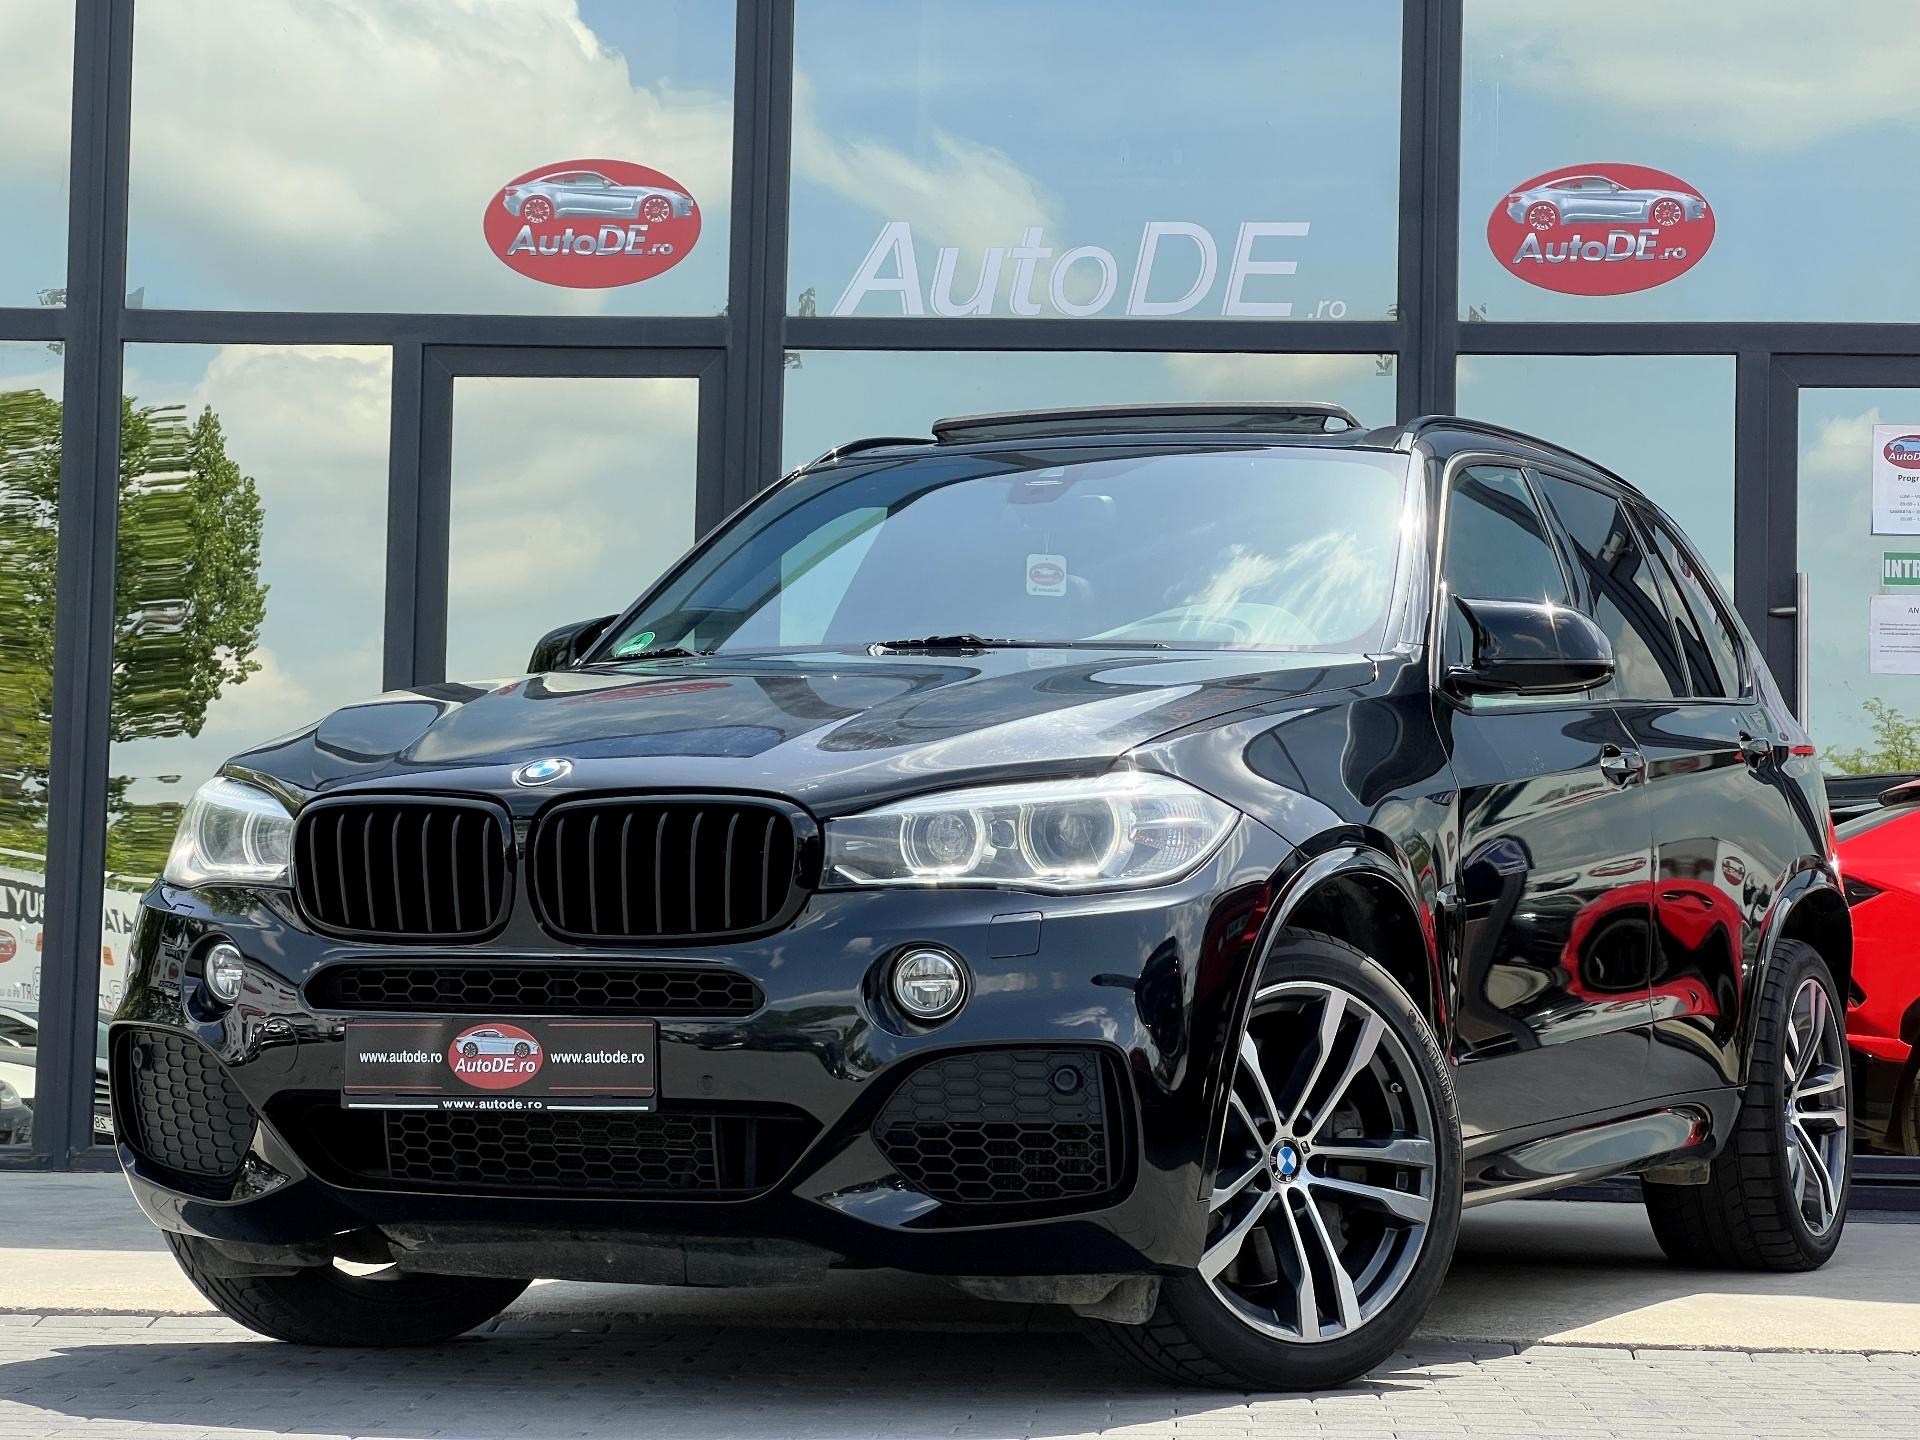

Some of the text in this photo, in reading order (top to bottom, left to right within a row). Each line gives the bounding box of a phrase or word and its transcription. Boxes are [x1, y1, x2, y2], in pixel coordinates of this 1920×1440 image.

[359, 1051, 646, 1073] www.autode.ro AutoDE.ro www.autode.ro
[442, 1099, 543, 1110] www.autode.ro
